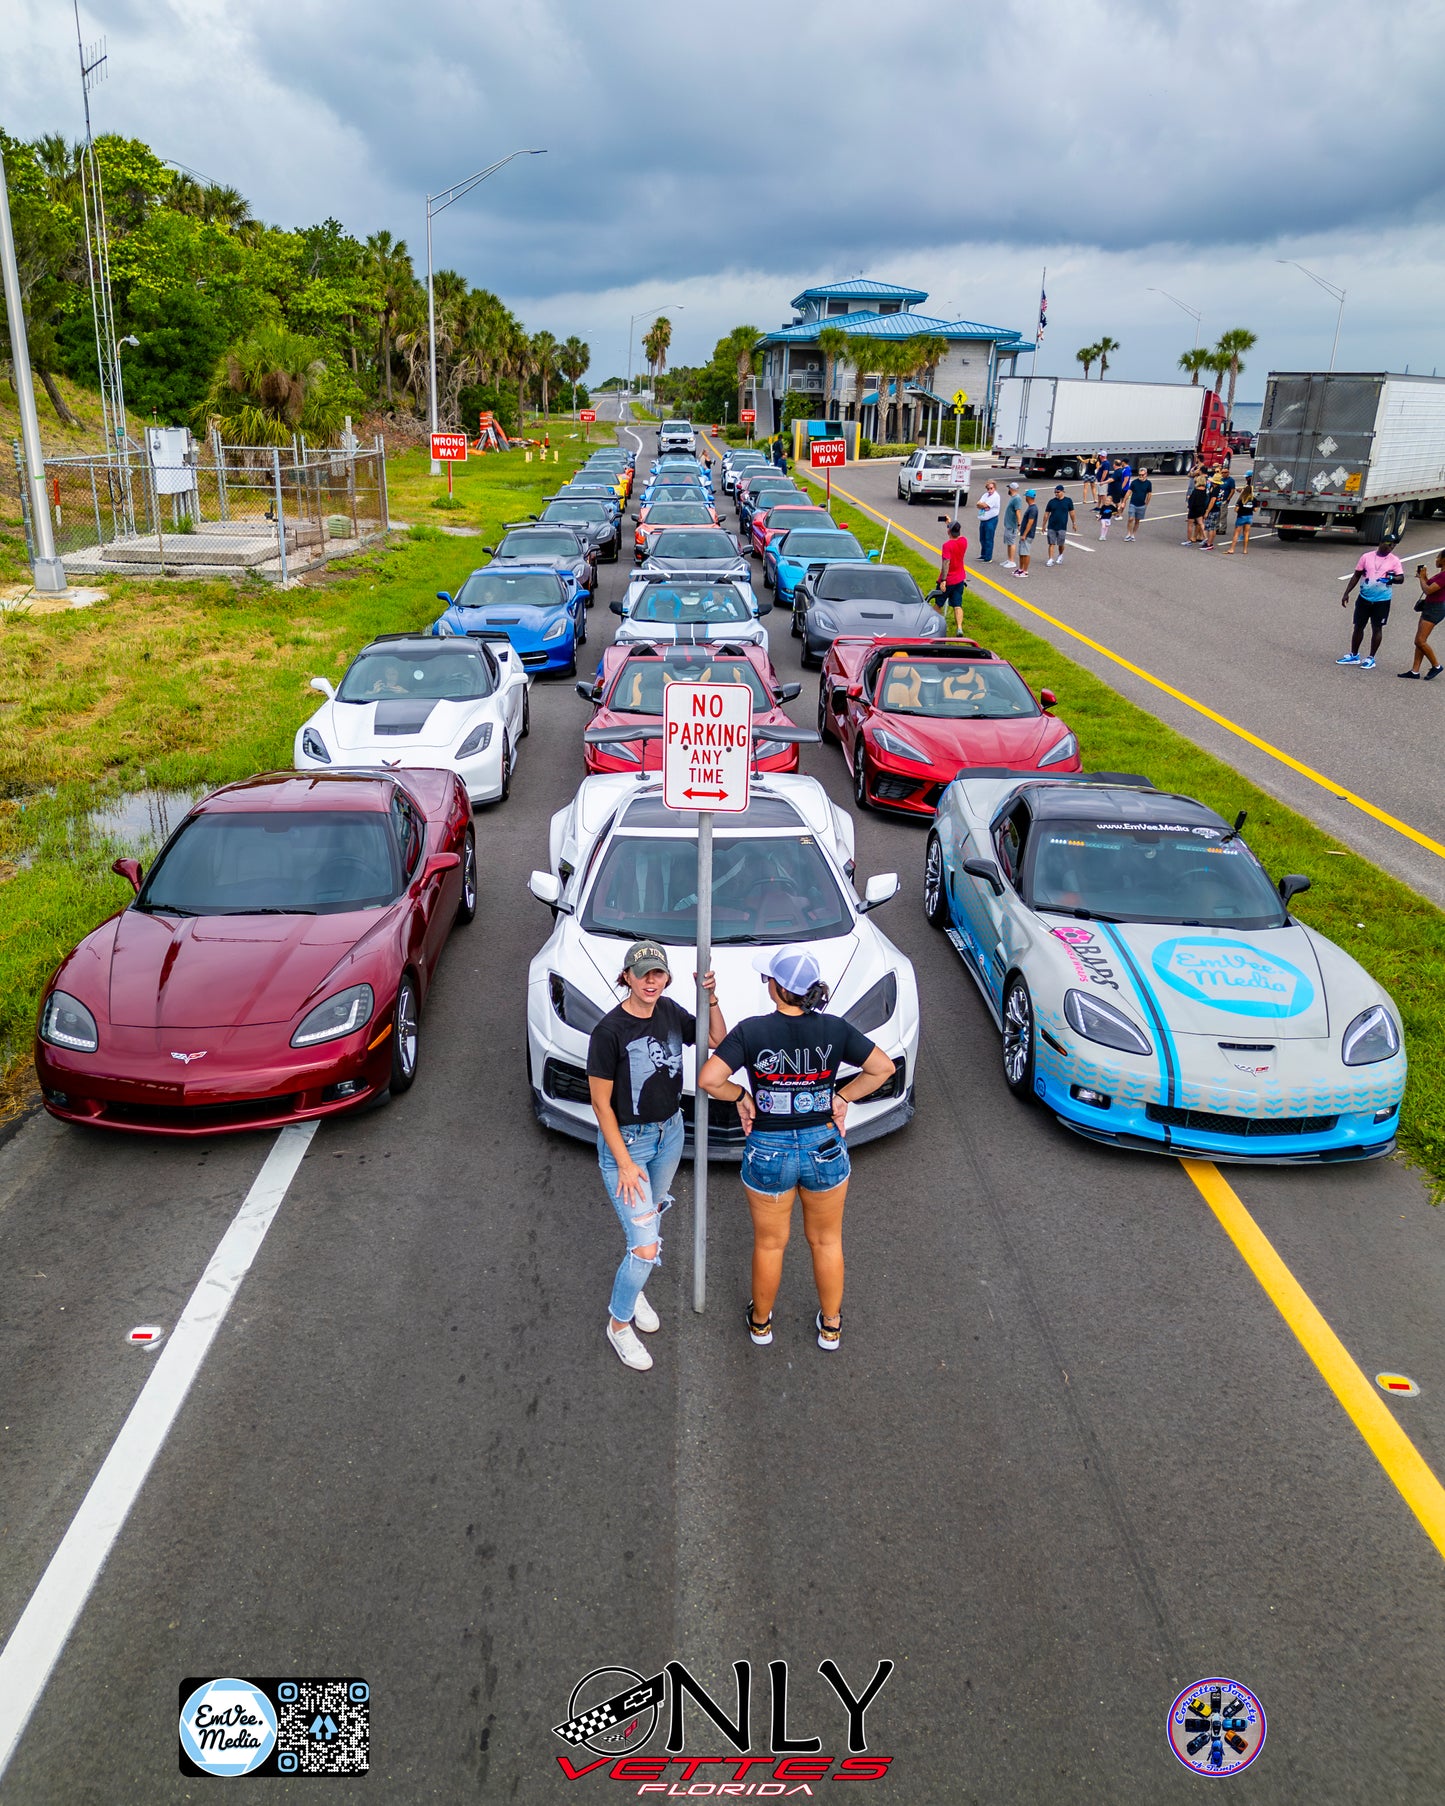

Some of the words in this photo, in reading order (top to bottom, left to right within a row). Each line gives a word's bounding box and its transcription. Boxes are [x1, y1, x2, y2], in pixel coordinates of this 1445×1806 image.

[432, 437, 464, 447] WRONG
[812, 444, 844, 454] WRONG
[439, 448, 458, 457] WAY
[819, 455, 838, 464] WAY
[692, 693, 723, 718] NO
[668, 721, 747, 747] PARKING
[690, 749, 722, 765] ANY
[688, 767, 724, 784] TIME
[1096, 823, 1190, 833] www.EmVee.Media
[633, 947, 648, 962] NEW
[1186, 969, 1287, 993] Media
[753, 1043, 833, 1075] ONLY
[754, 1069, 833, 1082] VETTES
